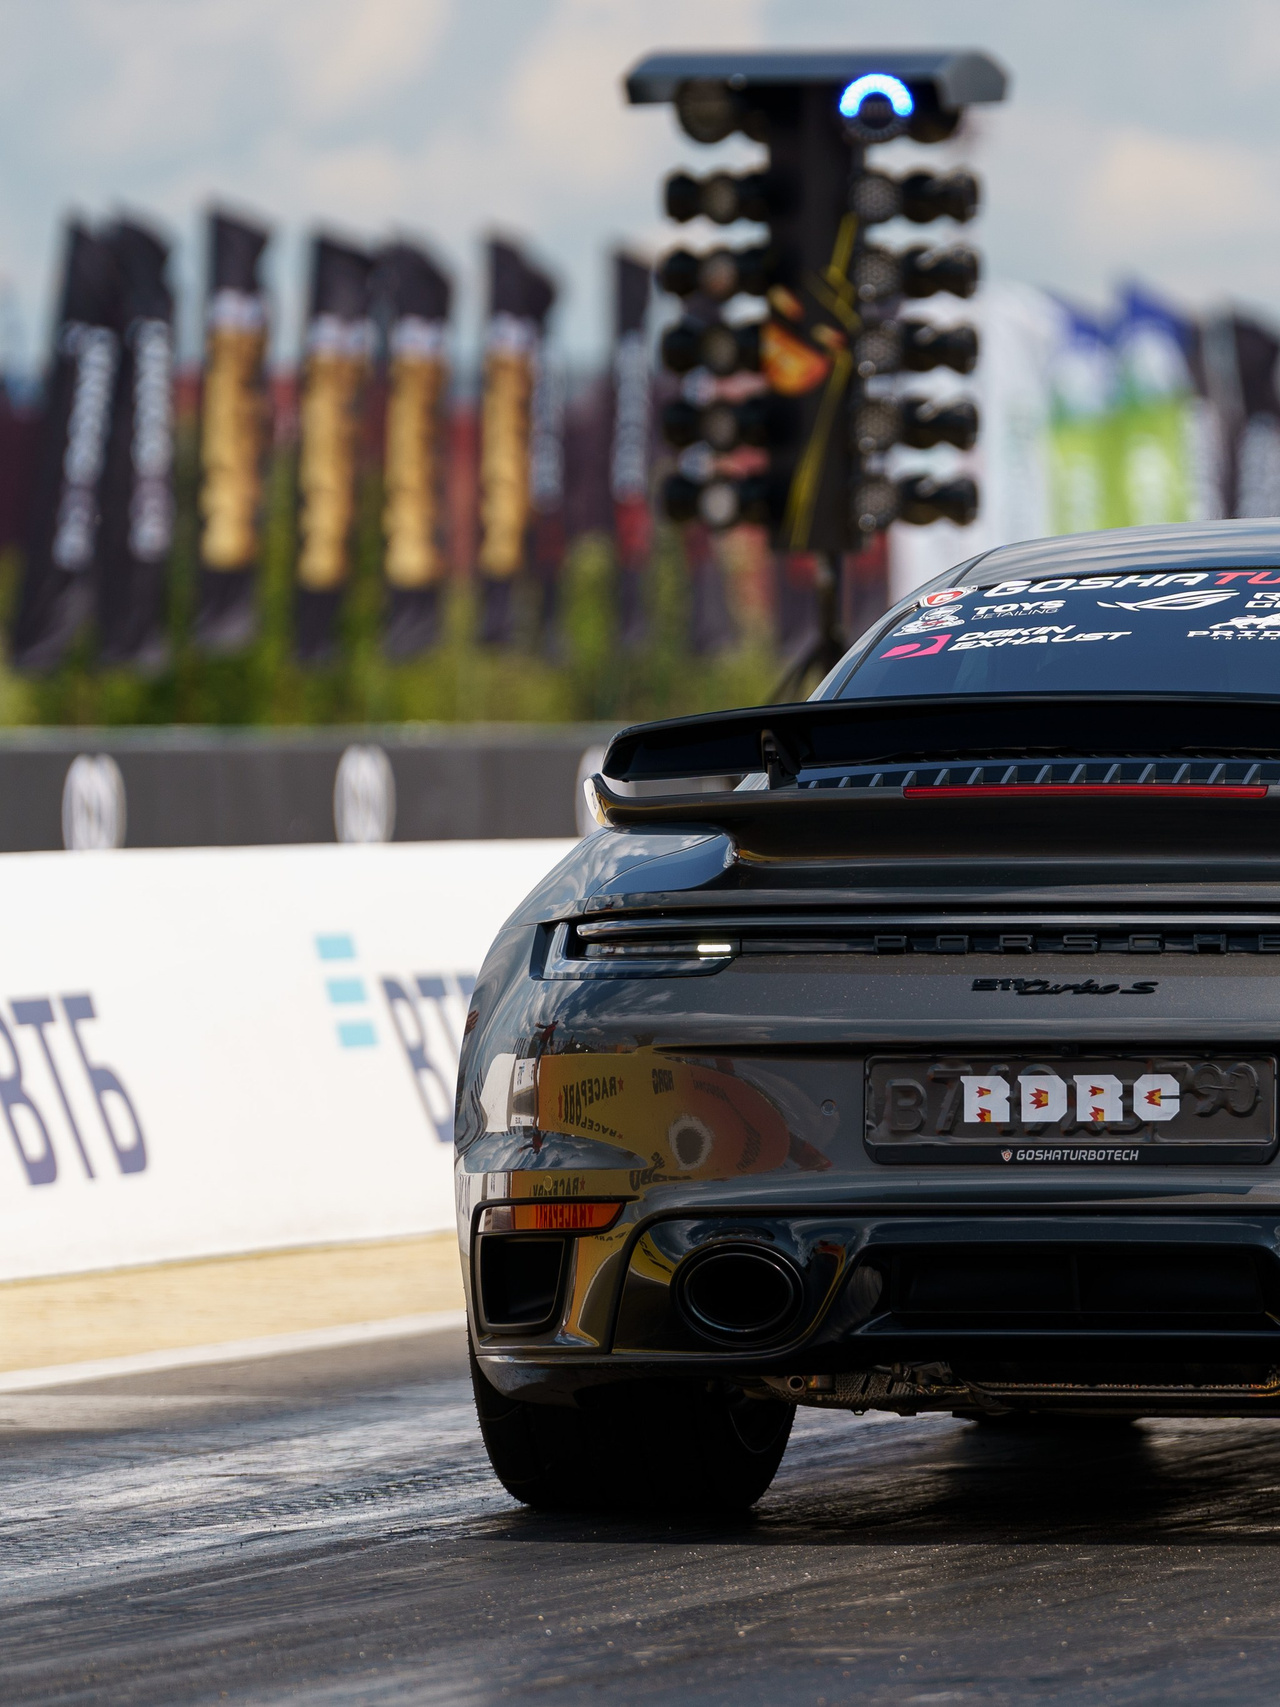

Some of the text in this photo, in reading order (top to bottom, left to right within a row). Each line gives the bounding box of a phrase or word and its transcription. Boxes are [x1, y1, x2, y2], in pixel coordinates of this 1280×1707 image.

[970, 608, 1060, 621] DETAILING
[973, 600, 1066, 616] TOYS
[947, 631, 1133, 652] EXHAUST
[955, 624, 1077, 642] DEIKIN
[1119, 981, 1159, 994] S
[380, 972, 475, 1144] ВТ
[960, 1073, 1180, 1123] RDRC
[1016, 1149, 1139, 1161] GOSHATURBOTECH
